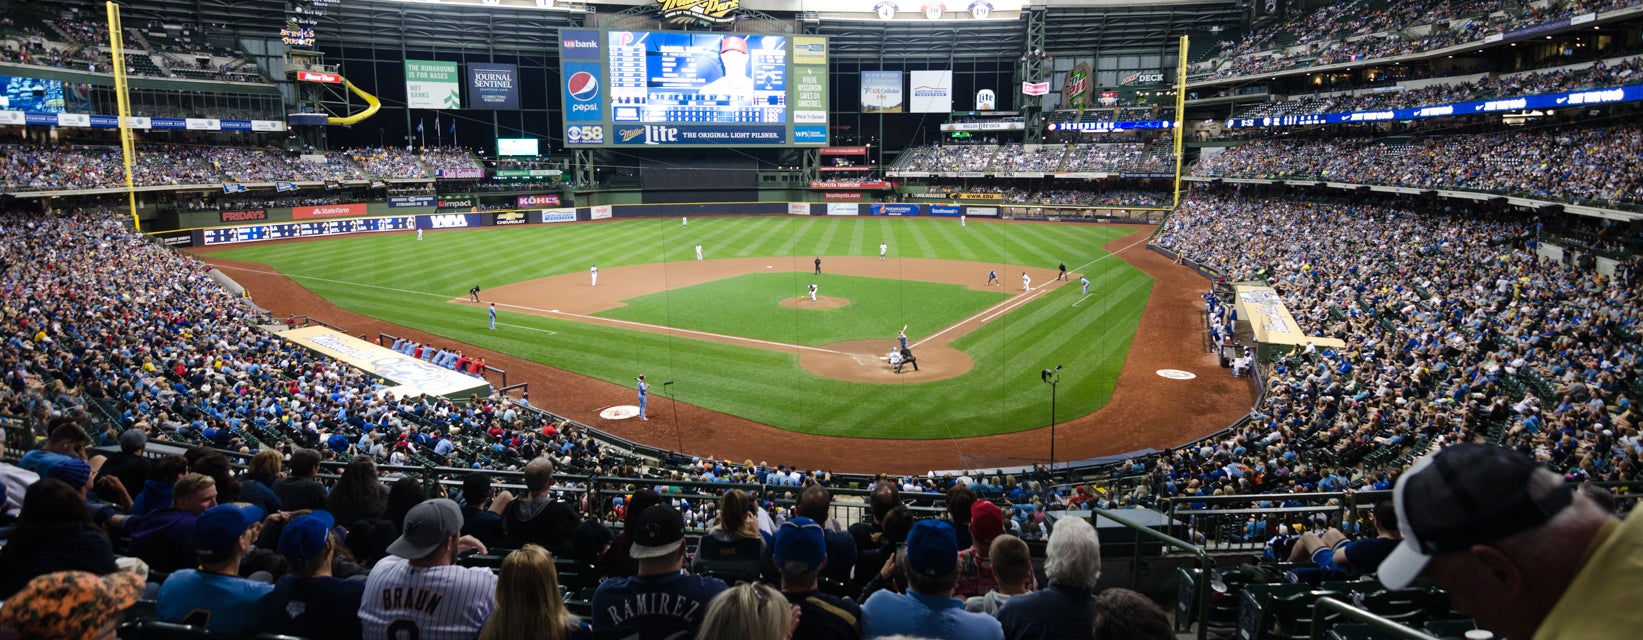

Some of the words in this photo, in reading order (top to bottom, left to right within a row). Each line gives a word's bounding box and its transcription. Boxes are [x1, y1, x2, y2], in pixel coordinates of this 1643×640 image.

[421, 65, 455, 73] RUNAROUND
[474, 73, 512, 81] JOURNAL
[979, 94, 994, 103] Lite
[572, 102, 598, 112] pepsi
[581, 126, 604, 140] 58
[619, 128, 645, 142] Miller
[644, 125, 679, 145] Lite
[444, 200, 472, 208] impact
[519, 196, 560, 204] KOHL'S
[382, 587, 442, 616] BRAUN
[607, 592, 700, 626] RAMIREZ
